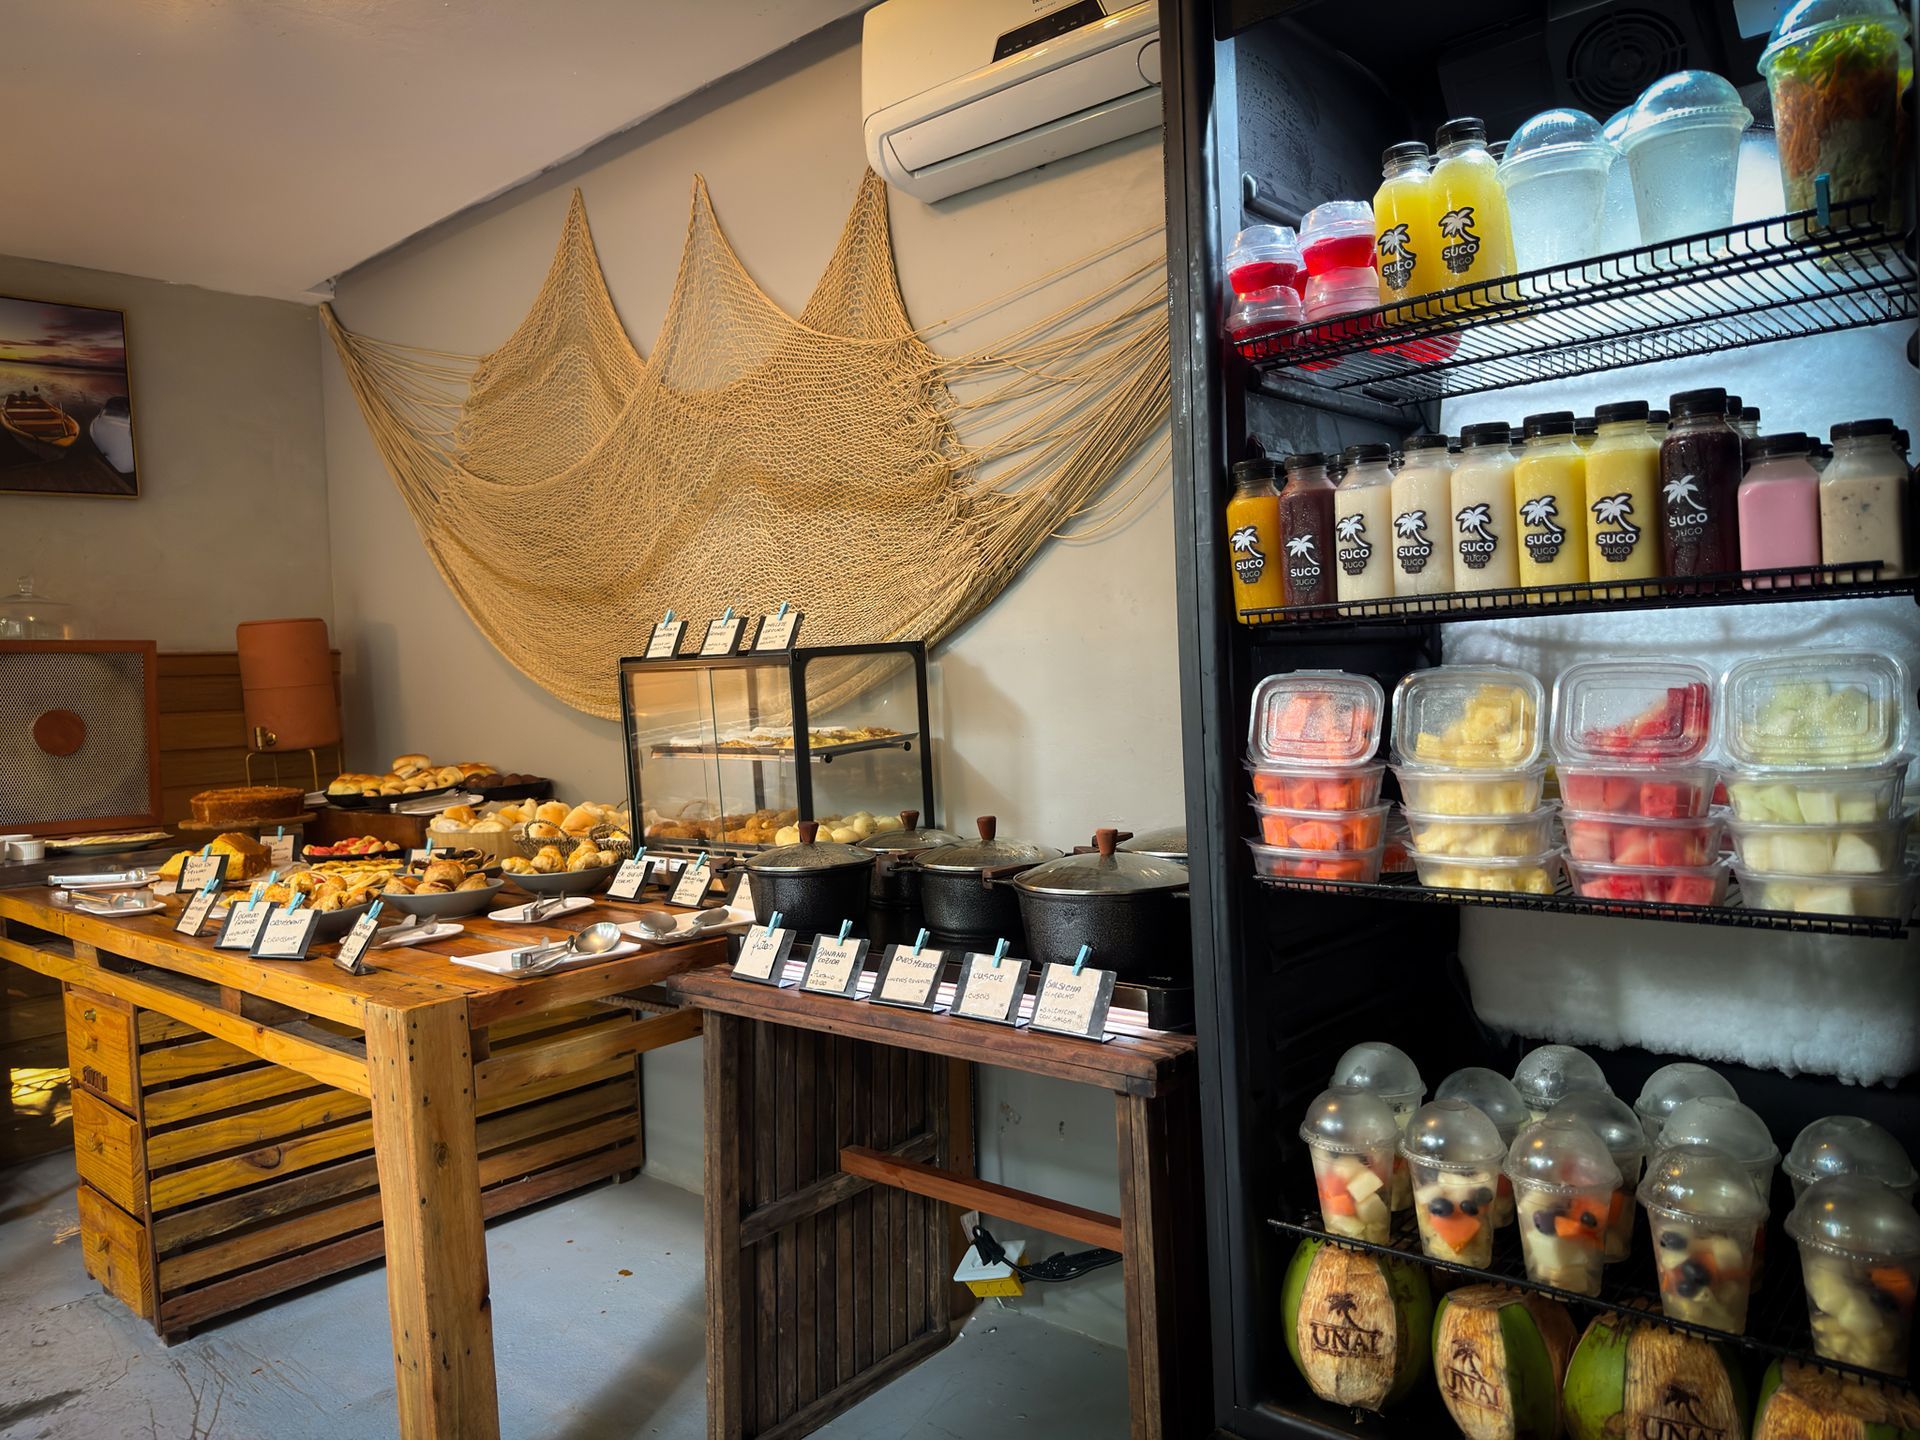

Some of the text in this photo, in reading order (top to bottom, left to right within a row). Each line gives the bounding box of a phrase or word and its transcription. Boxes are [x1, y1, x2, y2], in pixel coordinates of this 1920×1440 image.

[1443, 243, 1477, 260] SUCO
[1383, 260, 1414, 276] SUCO
[1669, 512, 1708, 528] SUCO
[1675, 526, 1704, 538] JUGO
[1526, 533, 1561, 545] SUCO
[1597, 533, 1637, 545] SUCO
[1398, 546, 1430, 557] SUCO
[1460, 541, 1495, 553] SUCO
[1532, 546, 1558, 556] JUGO
[1603, 546, 1631, 556] JUGO
[1340, 548, 1370, 560] SUCO
[1465, 554, 1489, 563] JUGO
[1235, 559, 1264, 571] SUCO
[1344, 560, 1366, 570] JUGO
[1402, 558, 1425, 567] JUGO
[1240, 570, 1261, 579] JUGO
[1290, 566, 1321, 578] SUCO
[1295, 578, 1317, 586] JUGO
[817, 957, 841, 966] COZIDA
[1311, 1323, 1381, 1354] UNAI
